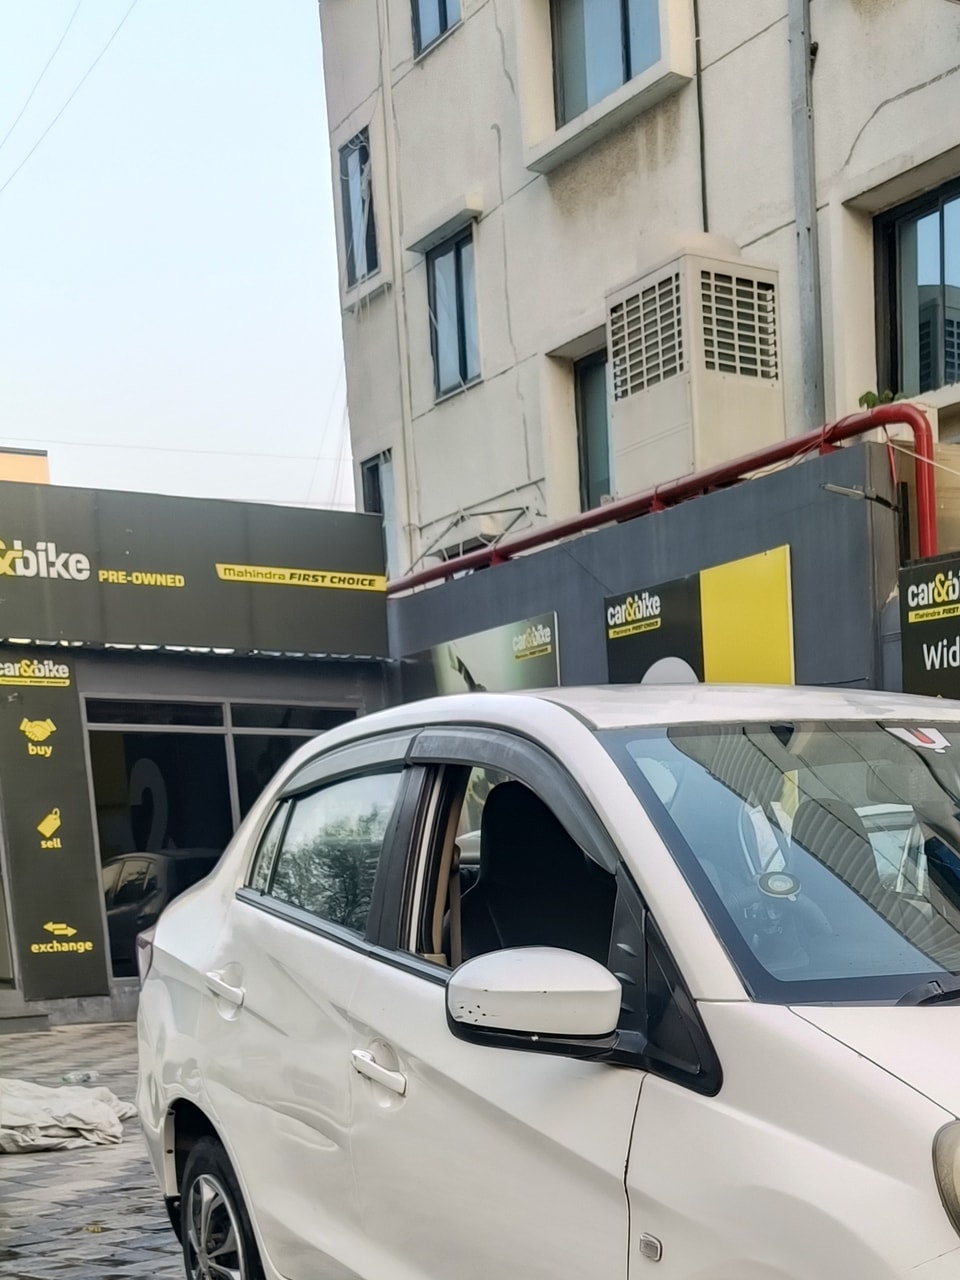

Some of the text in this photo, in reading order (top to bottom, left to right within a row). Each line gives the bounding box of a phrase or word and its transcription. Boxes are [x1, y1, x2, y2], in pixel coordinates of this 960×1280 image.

[98, 570, 185, 587] PRE-OWNED
[223, 567, 376, 587] Mahindra FIRST CHOICE
[607, 591, 661, 626] car&bike
[28, 743, 53, 758] buy
[40, 837, 62, 849] sell
[31, 940, 93, 953] exchange
